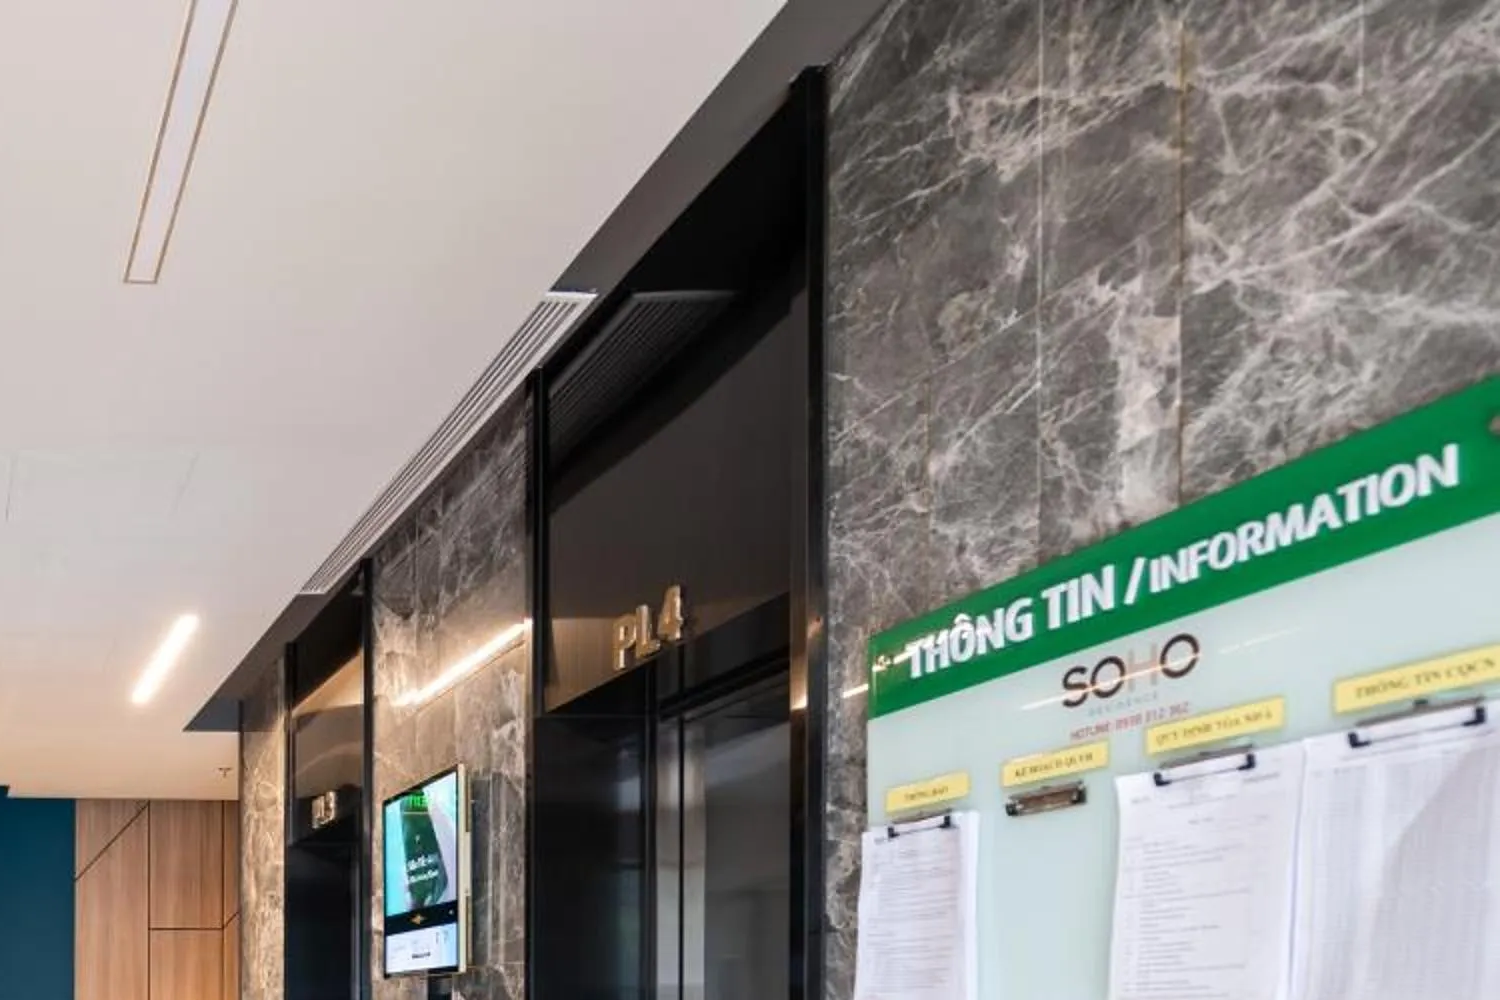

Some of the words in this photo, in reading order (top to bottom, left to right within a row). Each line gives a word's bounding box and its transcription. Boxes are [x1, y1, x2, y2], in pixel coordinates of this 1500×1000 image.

[612, 583, 684, 671] PL4
[907, 599, 1034, 679] THÔNG
[1041, 563, 1114, 630] TIN
[1062, 632, 1201, 708] SOHO
